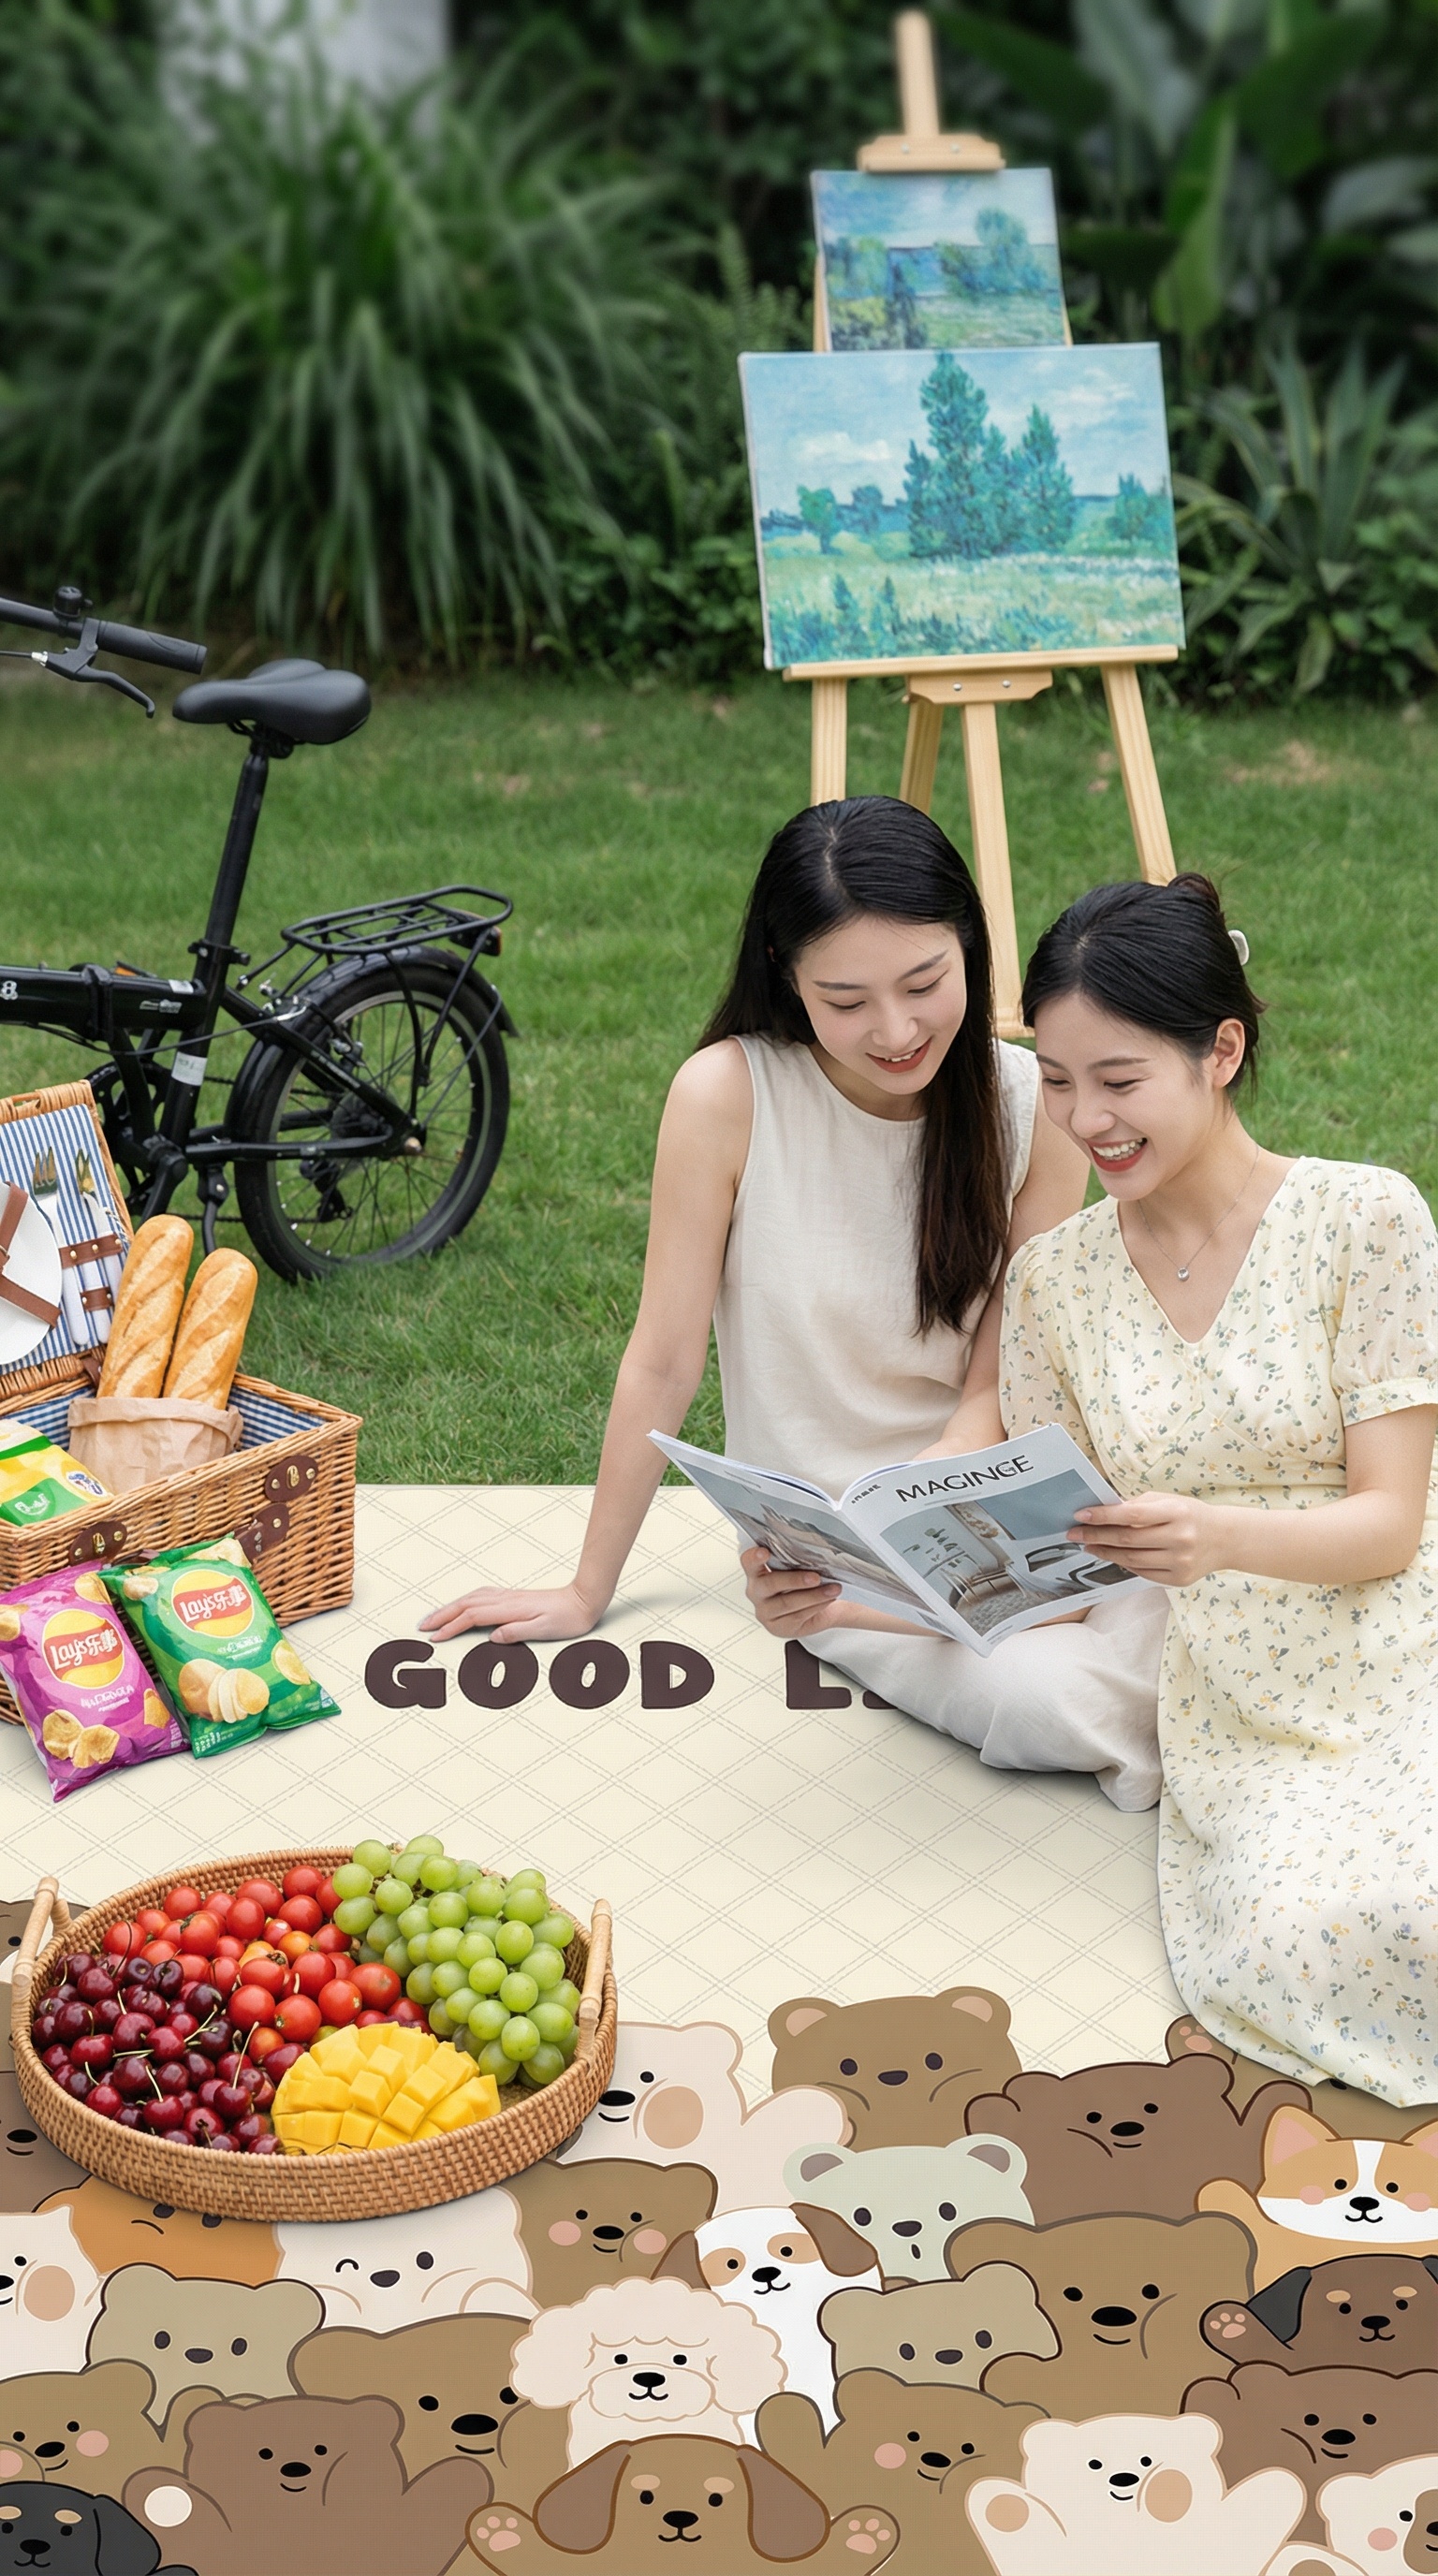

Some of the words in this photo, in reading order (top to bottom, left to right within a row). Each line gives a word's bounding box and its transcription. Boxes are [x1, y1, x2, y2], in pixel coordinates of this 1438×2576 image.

[895, 1455, 1034, 1503] MAGINGE
[364, 1638, 714, 1709] GOOD
[785, 1639, 899, 1710] L
